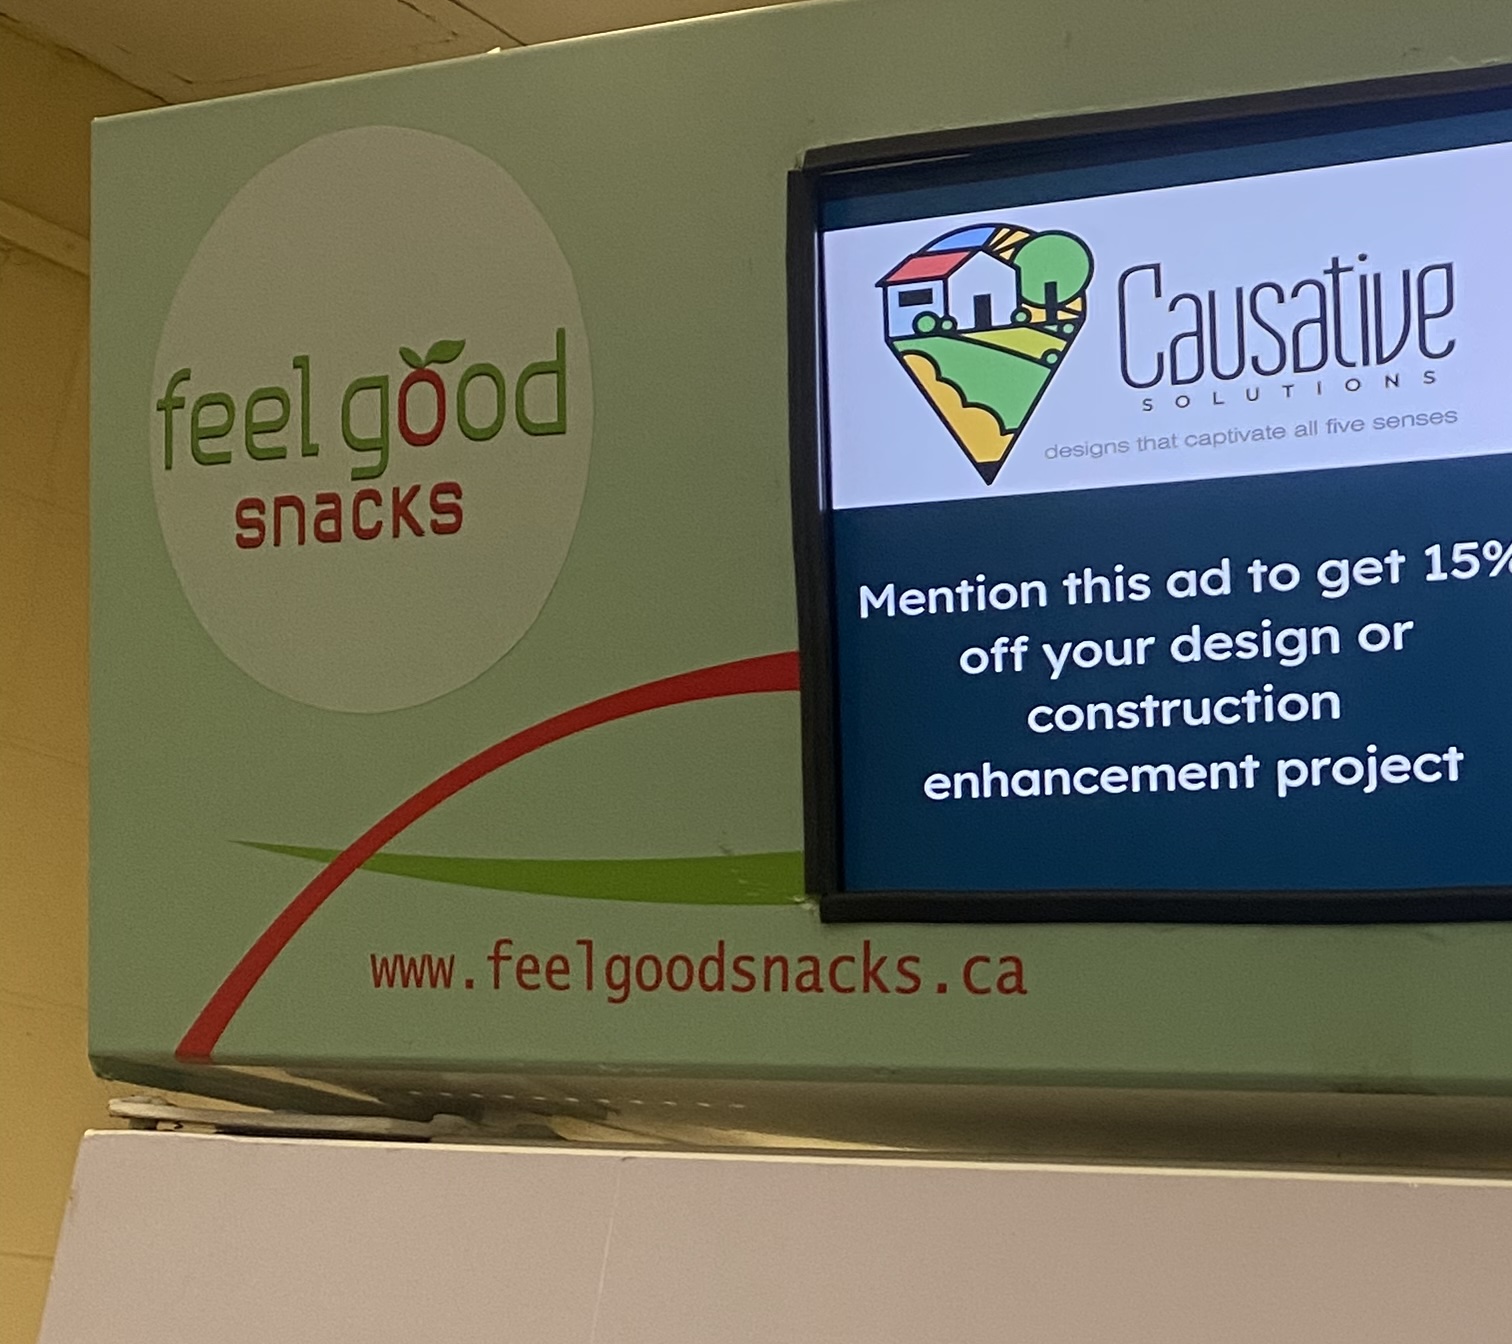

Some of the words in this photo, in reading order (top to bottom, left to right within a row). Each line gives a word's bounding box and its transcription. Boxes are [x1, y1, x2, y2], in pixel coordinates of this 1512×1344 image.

[1117, 253, 1457, 389] Causative
[155, 354, 320, 471] feel
[341, 327, 568, 481] good
[1142, 370, 1437, 412] SOLUTIONS
[1044, 439, 1131, 461] designs
[1136, 434, 1179, 453] that
[1184, 424, 1287, 449] captivate
[1294, 420, 1319, 438] all
[1325, 417, 1366, 434] five
[1372, 409, 1458, 431] senses
[235, 481, 465, 550] snacks
[858, 576, 1048, 619] Mention
[1062, 563, 1151, 607] this
[1165, 557, 1232, 599] ad
[1247, 559, 1301, 593] to
[1317, 548, 1407, 601] get
[959, 634, 1028, 676] off
[1042, 633, 1156, 679] your
[1170, 618, 1341, 667] design
[1357, 618, 1414, 653] or
[1027, 682, 1342, 734] construction
[923, 754, 1260, 801] enhancement
[1276, 743, 1465, 797] project
[368, 939, 1029, 1004] www.feelgoodsnacks.ca
